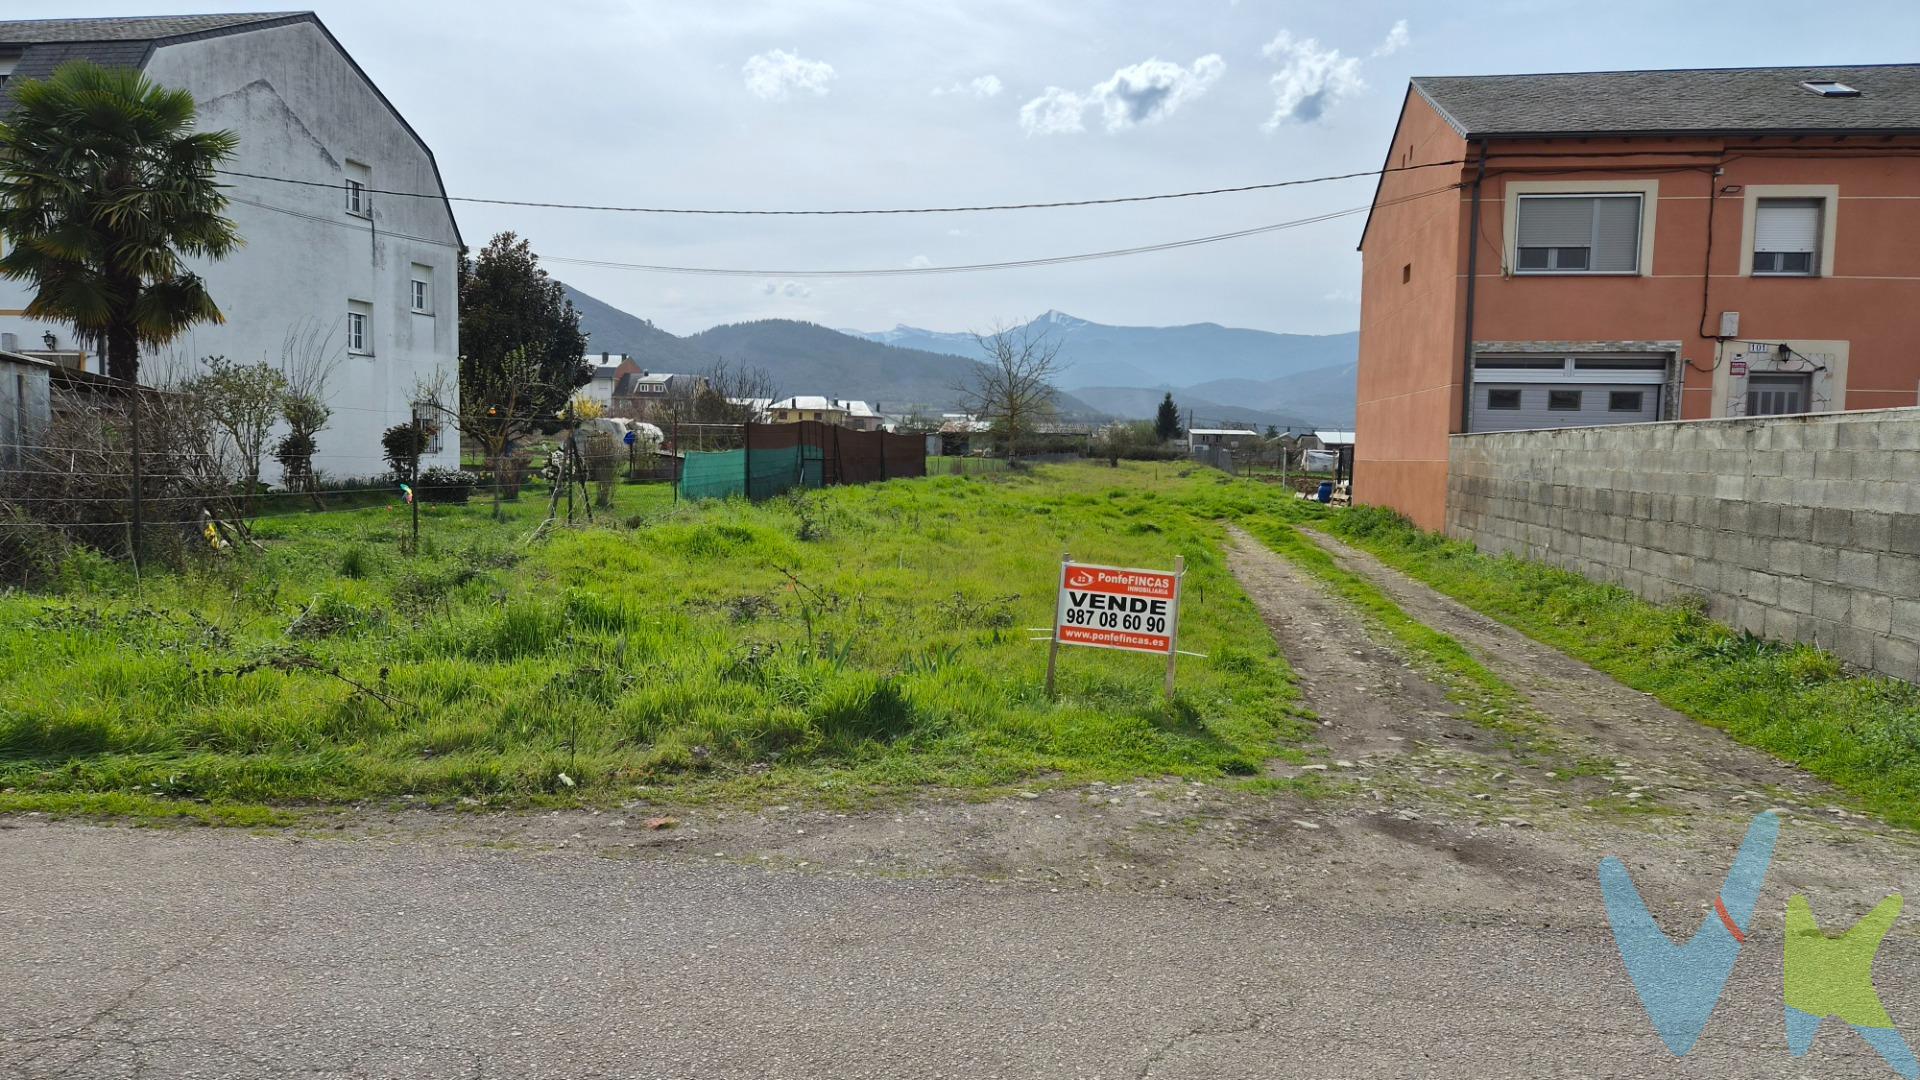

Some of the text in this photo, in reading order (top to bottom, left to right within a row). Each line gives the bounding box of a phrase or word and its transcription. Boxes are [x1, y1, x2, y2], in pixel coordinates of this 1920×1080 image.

[1098, 572, 1169, 588] PonfeFINCAS
[1069, 591, 1167, 616] VENDE
[1066, 608, 1165, 633] 987 08 60 90
[1065, 629, 1164, 646] www.ponfefincas.es
